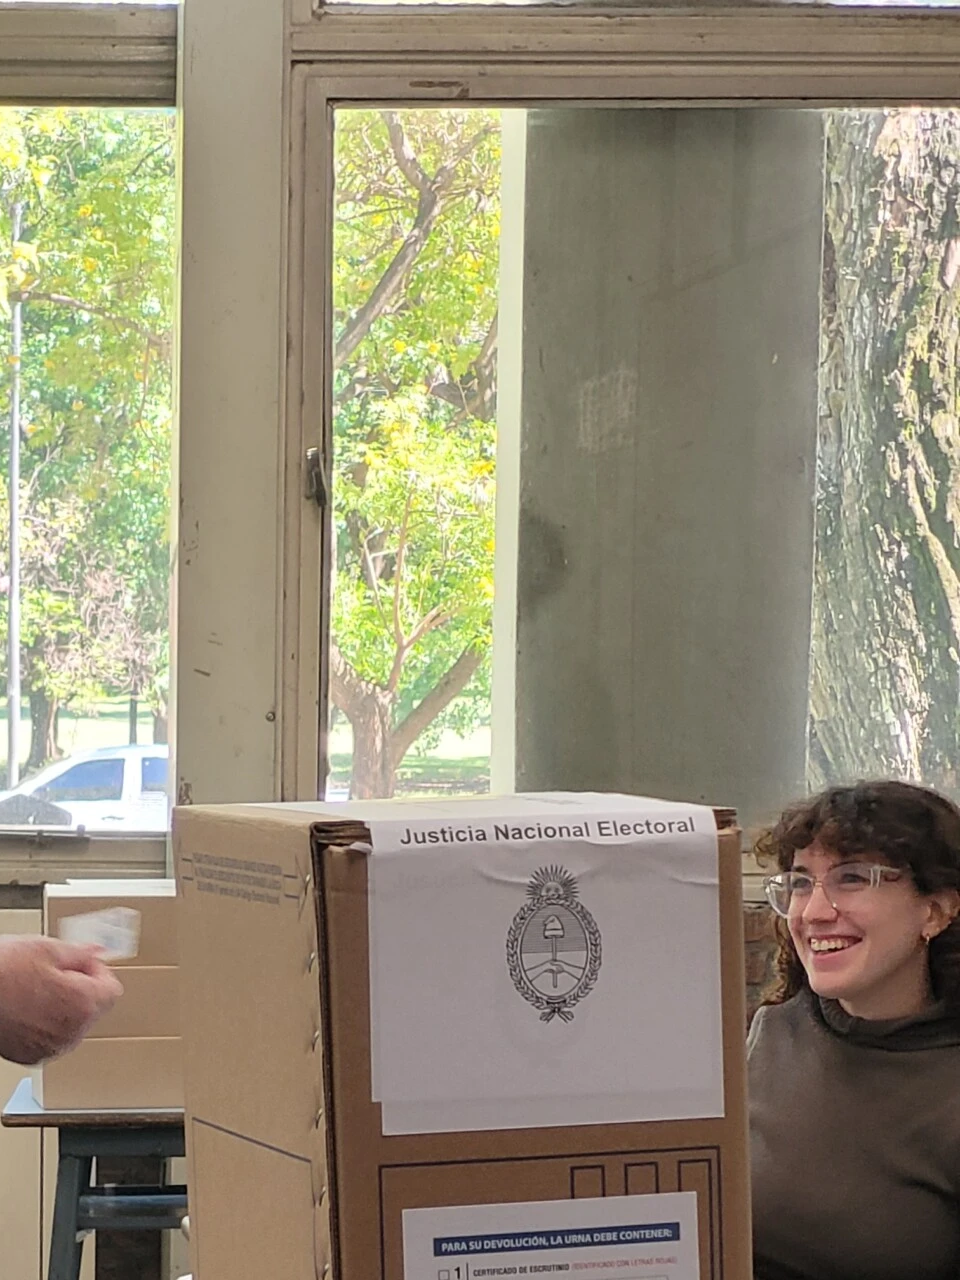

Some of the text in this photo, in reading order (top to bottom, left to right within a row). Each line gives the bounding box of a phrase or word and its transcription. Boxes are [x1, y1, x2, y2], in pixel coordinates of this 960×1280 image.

[400, 817, 696, 846] Justicia Nacional Electoral
[441, 1228, 673, 1252] PARA SU DEVOLUCIÓN, LA URNA DEBE CONTENER:
[454, 1267, 461, 1280] 1
[473, 1266, 517, 1277] CERTIFICADO
[519, 1265, 528, 1274] DE
[530, 1263, 570, 1274] ESCRUTINIO
